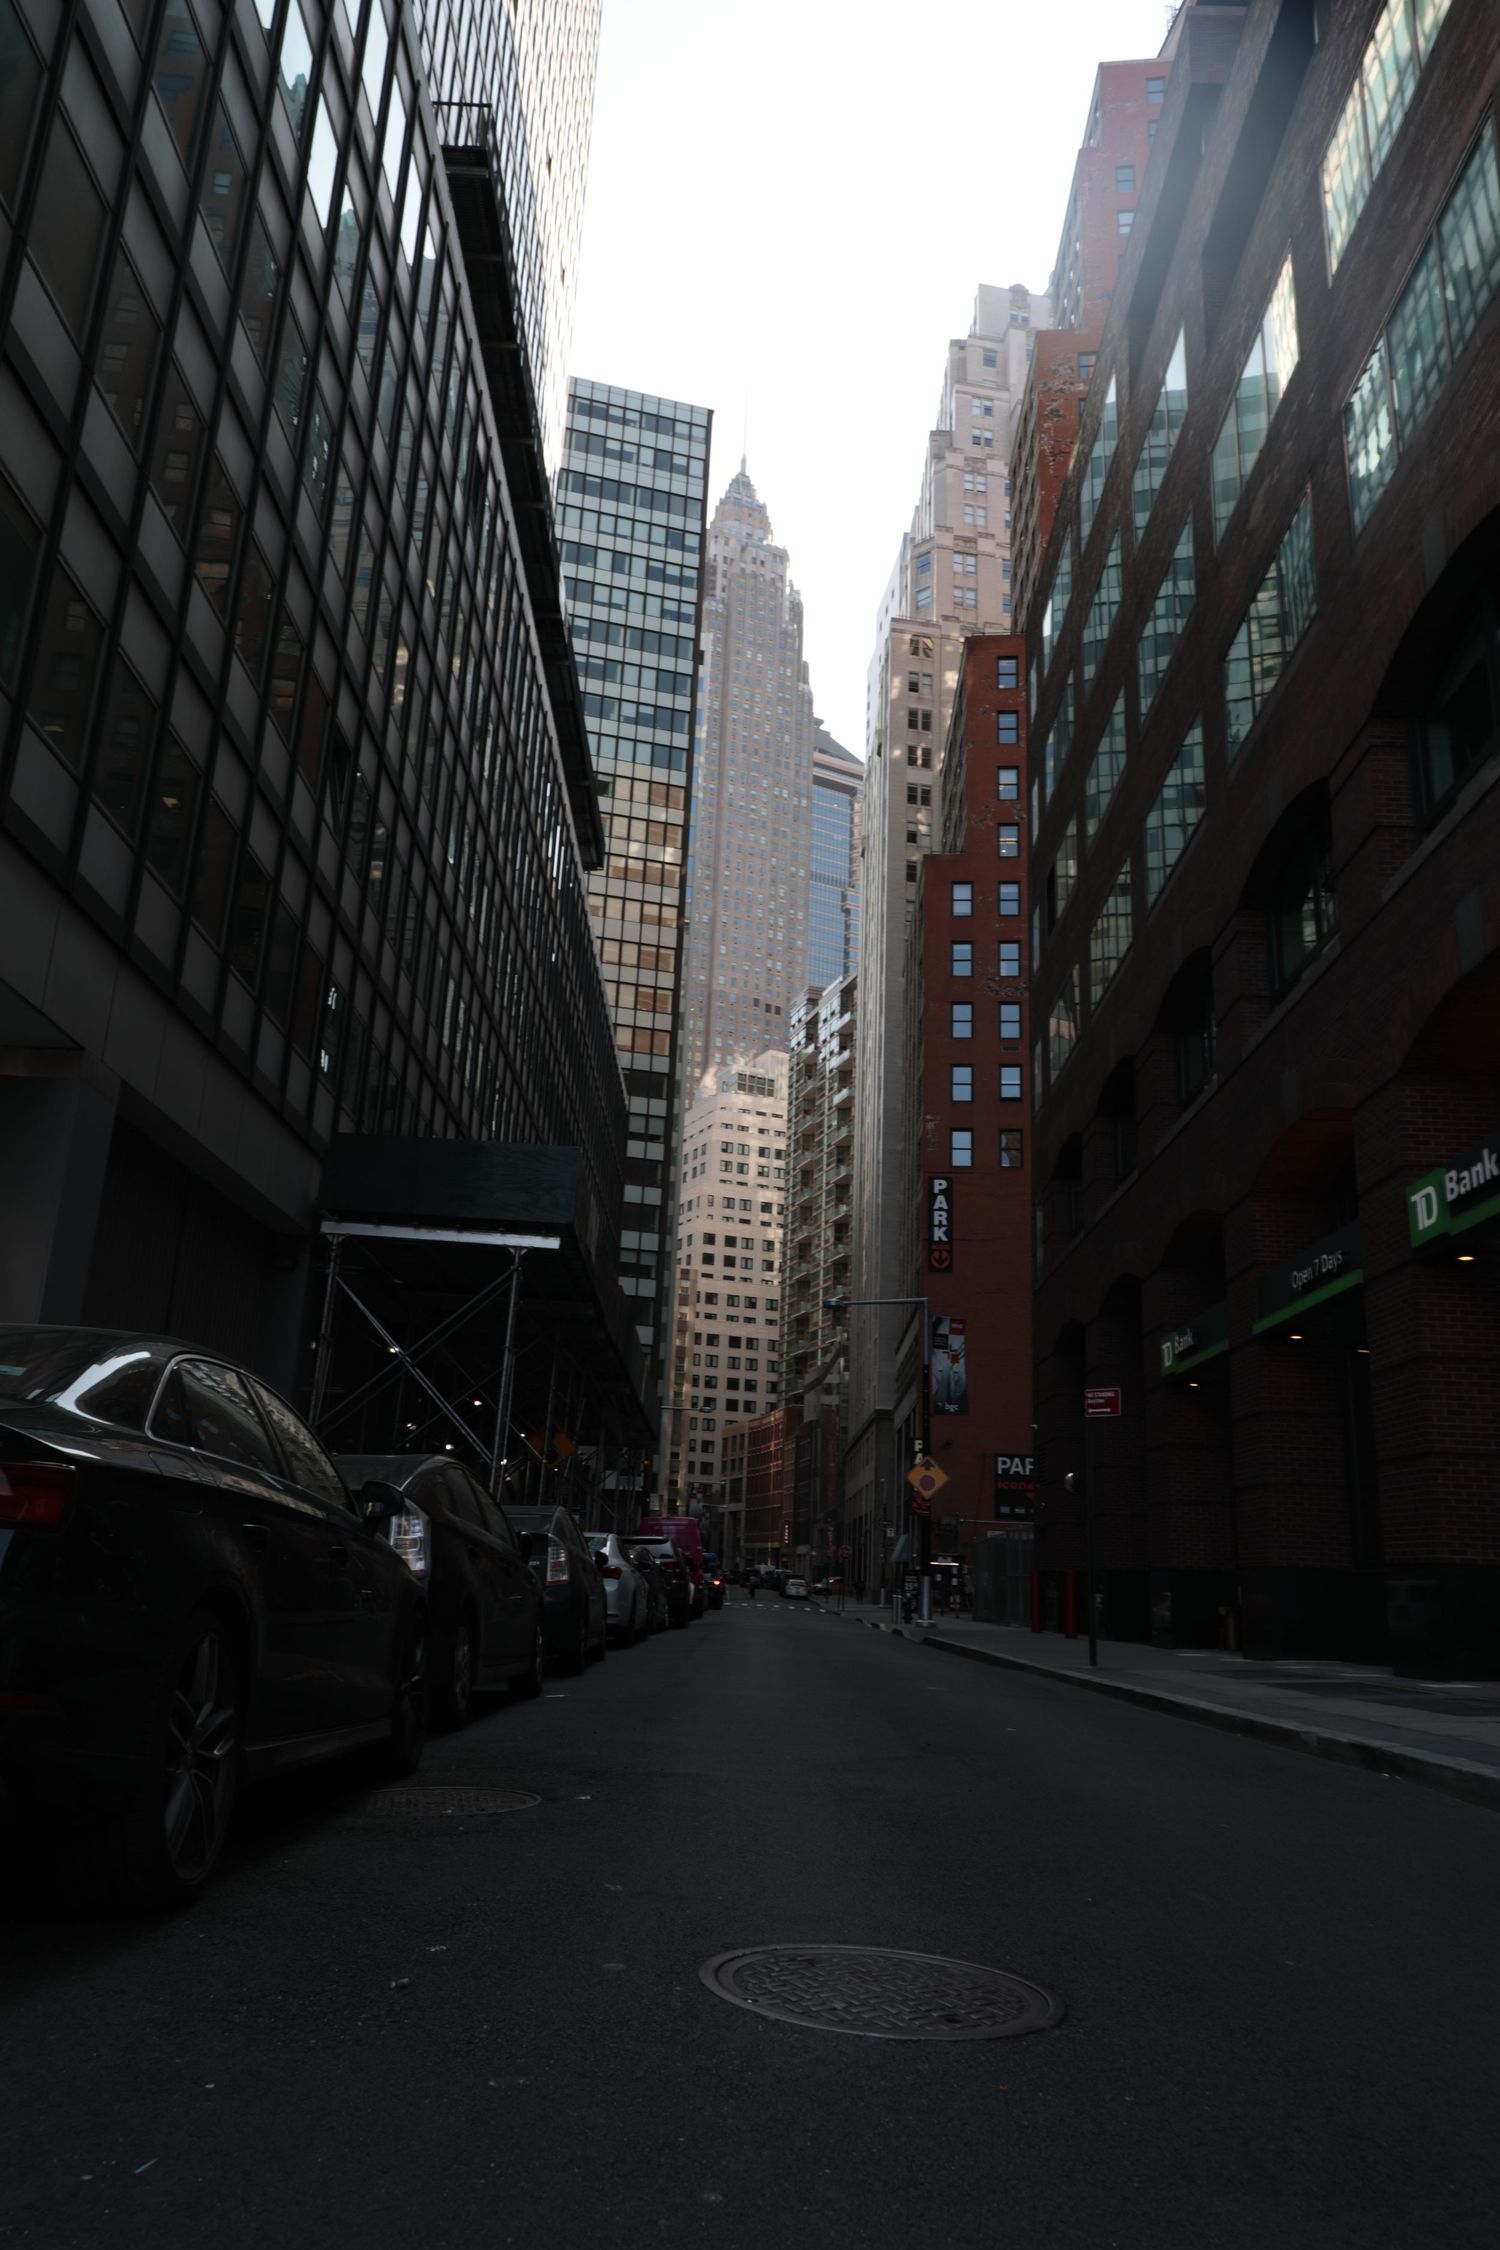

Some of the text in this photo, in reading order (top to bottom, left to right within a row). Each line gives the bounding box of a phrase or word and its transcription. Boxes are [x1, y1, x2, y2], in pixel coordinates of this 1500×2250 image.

[933, 1179, 949, 1241] PARK
[1410, 1147, 1500, 1230] TD Bank
[1291, 1249, 1343, 1291] Open 7 Days
[1161, 1328, 1193, 1367] TD Bank
